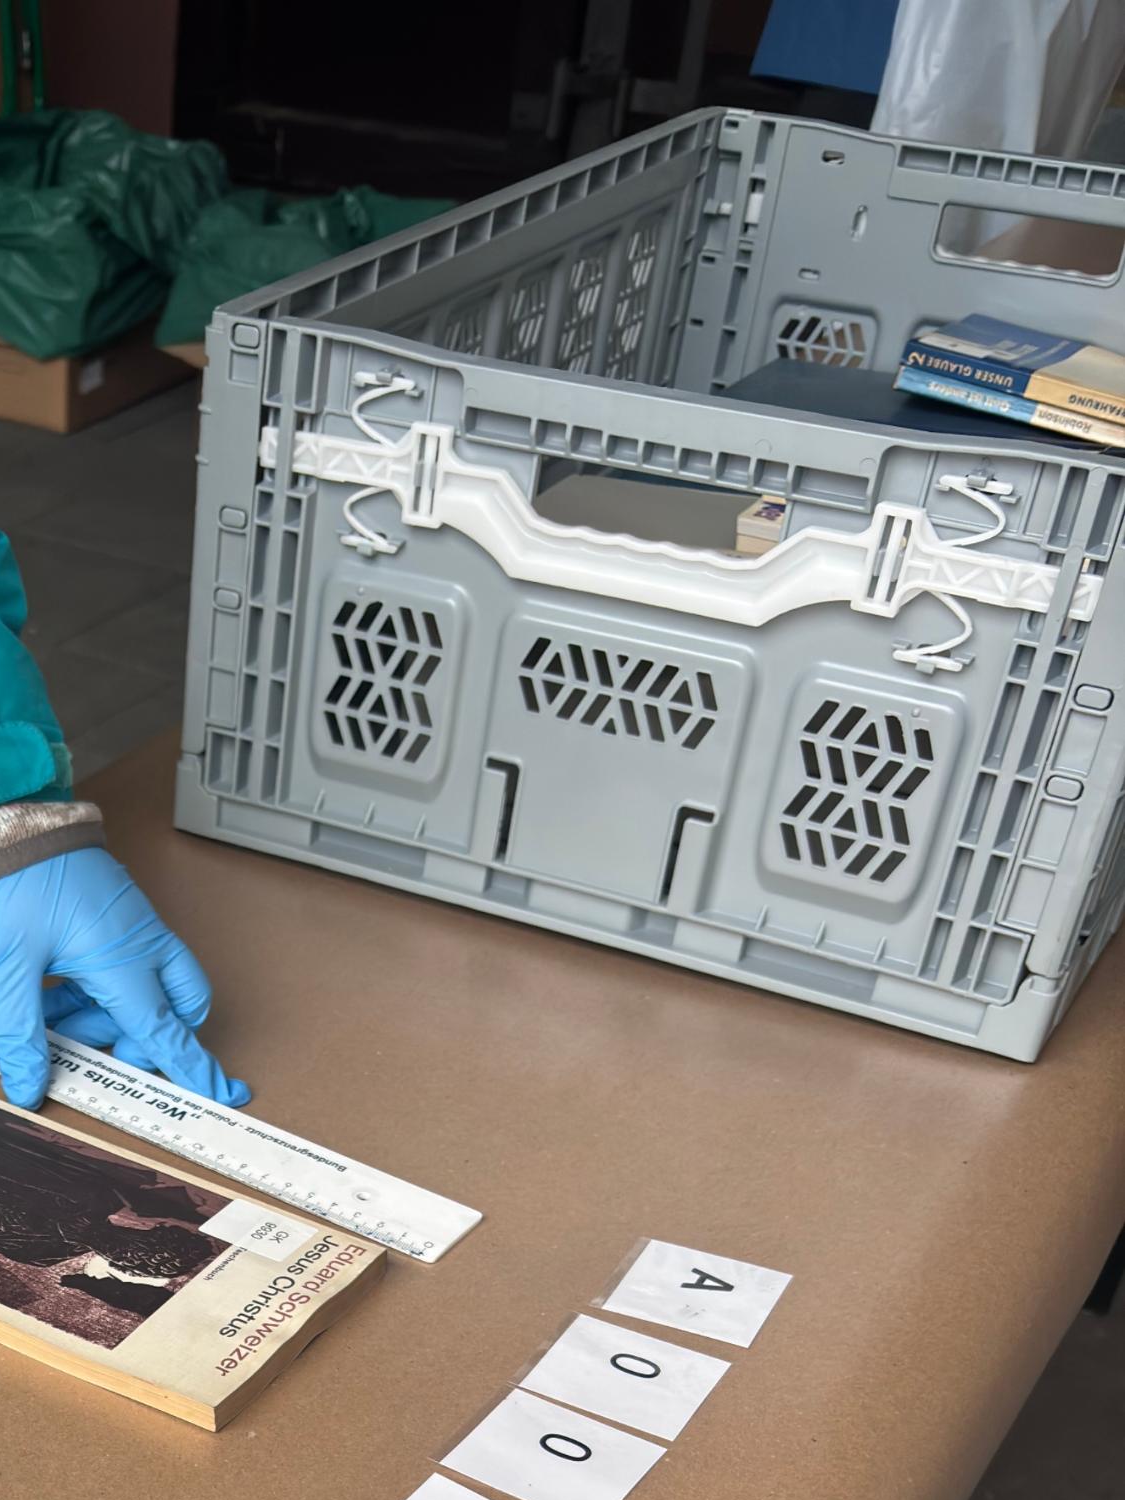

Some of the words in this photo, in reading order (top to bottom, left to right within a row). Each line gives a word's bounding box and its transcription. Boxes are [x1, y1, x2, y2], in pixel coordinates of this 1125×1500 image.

[907, 352, 925, 366] 2
[926, 356, 974, 377] GLAUBE
[975, 368, 1014, 388] UNSER
[1037, 409, 1093, 434] Robinson
[83, 1068, 145, 1101] nichts
[145, 1083, 183, 1102] Bundes
[184, 1099, 202, 1111] des
[202, 1107, 238, 1128] Polizei
[245, 1127, 347, 1172] Bundesgrenzschutz
[251, 1222, 277, 1240] 9930
[269, 1230, 290, 1244] GK
[287, 1235, 339, 1275] Jesus
[302, 1244, 366, 1293] Eduard
[680, 1267, 735, 1294] A
[219, 1276, 295, 1338] Christus
[215, 1292, 311, 1377] Schweizer
